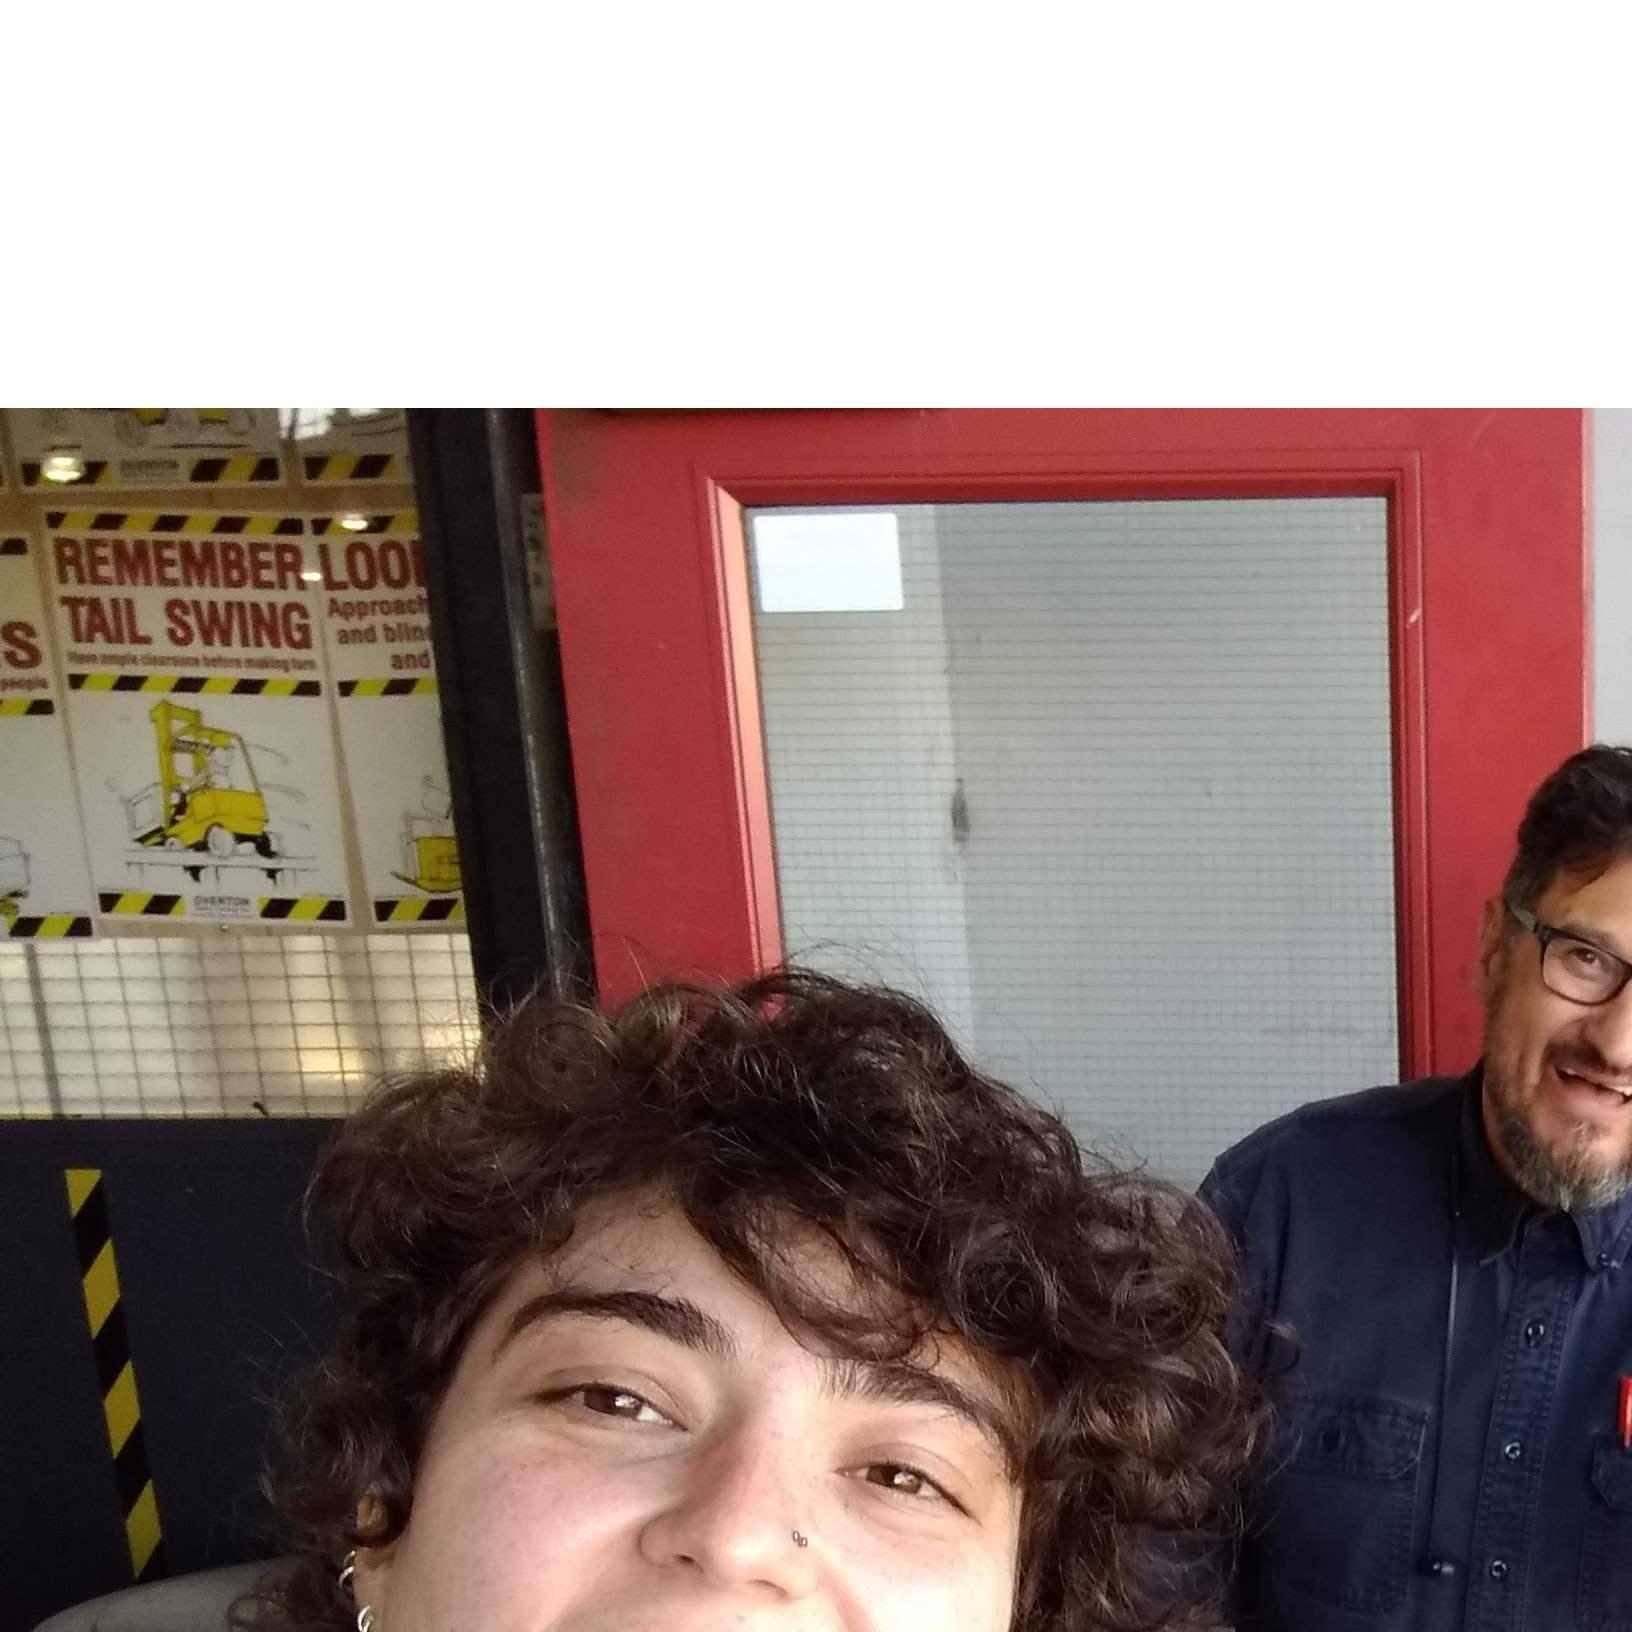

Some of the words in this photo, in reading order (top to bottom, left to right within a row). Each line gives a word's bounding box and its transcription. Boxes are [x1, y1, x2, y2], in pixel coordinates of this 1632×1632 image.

[54, 537, 306, 591] REMEMBER
[61, 596, 152, 645] TAIL
[164, 598, 312, 650] SWING
[383, 622, 426, 643] blin
[391, 650, 430, 670] and
